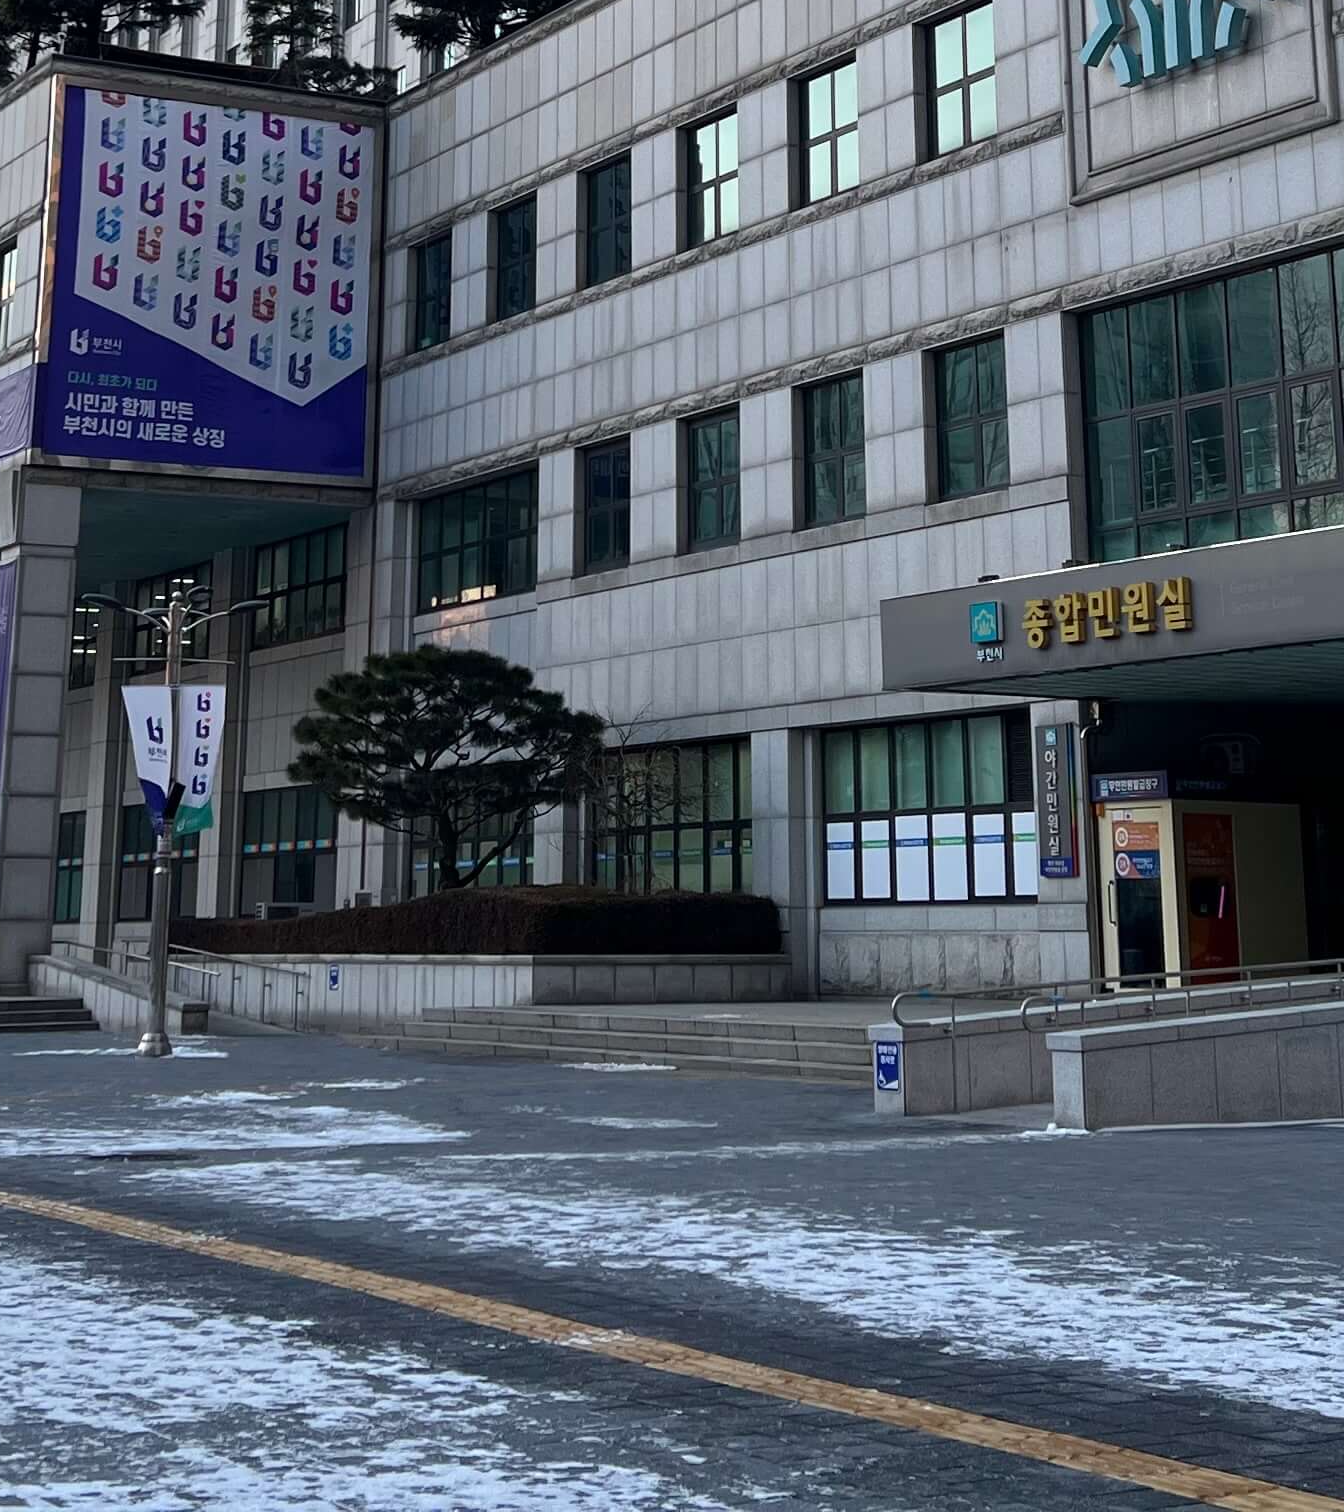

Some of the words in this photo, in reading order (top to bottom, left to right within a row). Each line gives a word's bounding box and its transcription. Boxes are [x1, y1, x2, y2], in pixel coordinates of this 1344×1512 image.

[93, 337, 123, 351] 부천시
[64, 391, 119, 415] 시민과
[121, 396, 156, 419] 함께
[160, 400, 195, 422] 만든
[62, 415, 133, 439] 부천시의
[136, 422, 189, 444] 새로운
[192, 426, 225, 449] 상징
[1022, 576, 1194, 649] 종합민원실
[1044, 750, 1060, 857] 야간민원실
